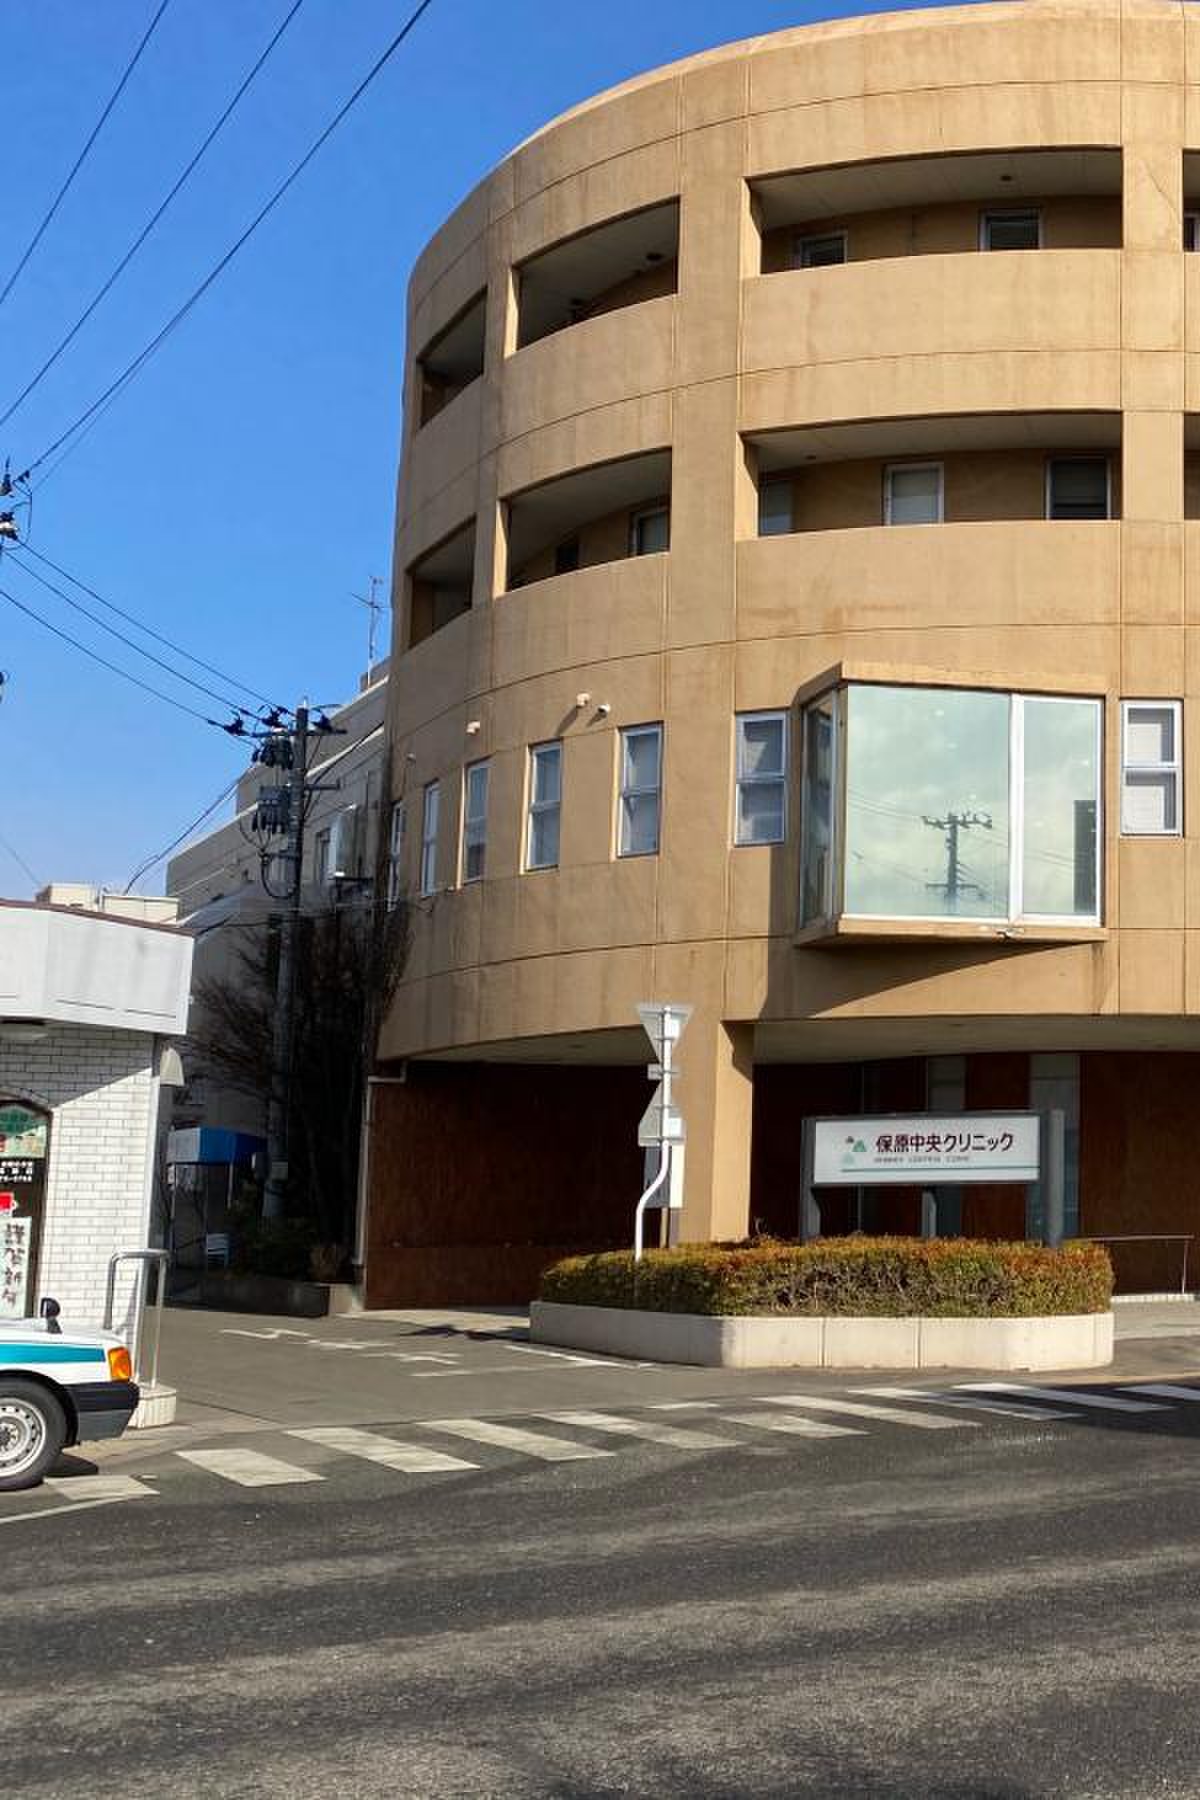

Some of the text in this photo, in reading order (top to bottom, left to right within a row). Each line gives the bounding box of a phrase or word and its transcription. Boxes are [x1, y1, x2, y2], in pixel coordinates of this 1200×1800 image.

[875, 1132, 1014, 1153] 保原中央クリニック
